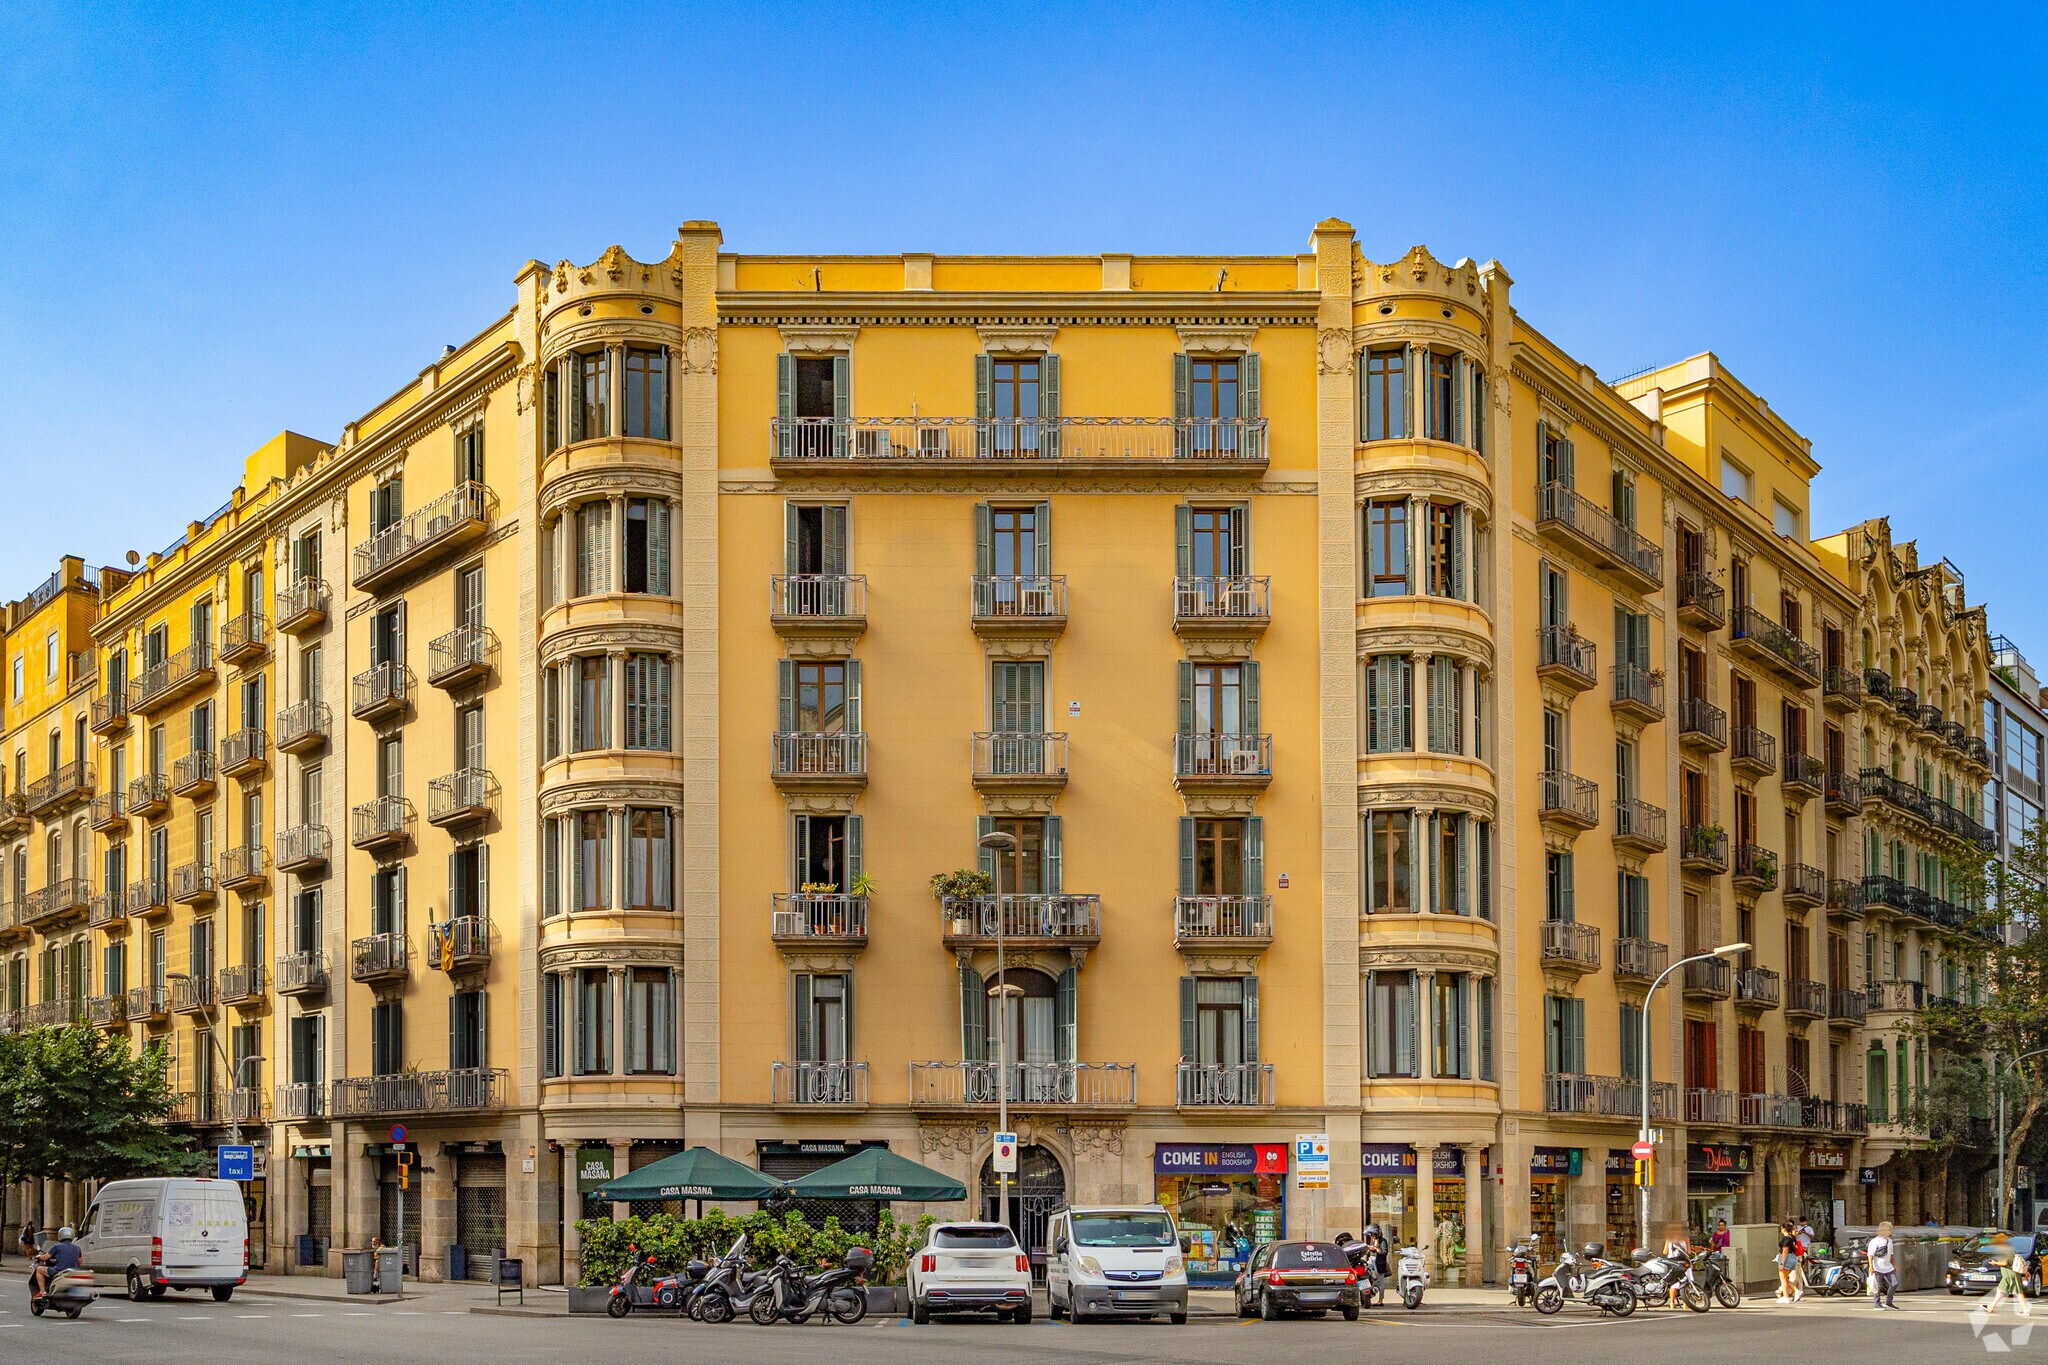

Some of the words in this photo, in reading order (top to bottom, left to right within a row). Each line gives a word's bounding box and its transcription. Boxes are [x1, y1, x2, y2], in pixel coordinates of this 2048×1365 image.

[801, 1144, 817, 1152] CASA
[818, 1144, 845, 1152] MASANA
[1300, 1142, 1310, 1154] P
[1162, 1152, 1201, 1165] COME
[1204, 1152, 1218, 1165] IN
[1221, 1151, 1246, 1159] ENGLISH
[1362, 1153, 1399, 1166] COME
[1402, 1153, 1416, 1166] IN
[1433, 1151, 1450, 1159] GLISH
[1702, 1147, 1732, 1172] Dylan
[586, 1161, 604, 1170] CASA
[580, 1169, 610, 1179] MASANA
[660, 1187, 680, 1196] CASA
[681, 1186, 713, 1196] MASANA
[849, 1186, 869, 1195] CASA
[870, 1186, 902, 1195] MASANA
